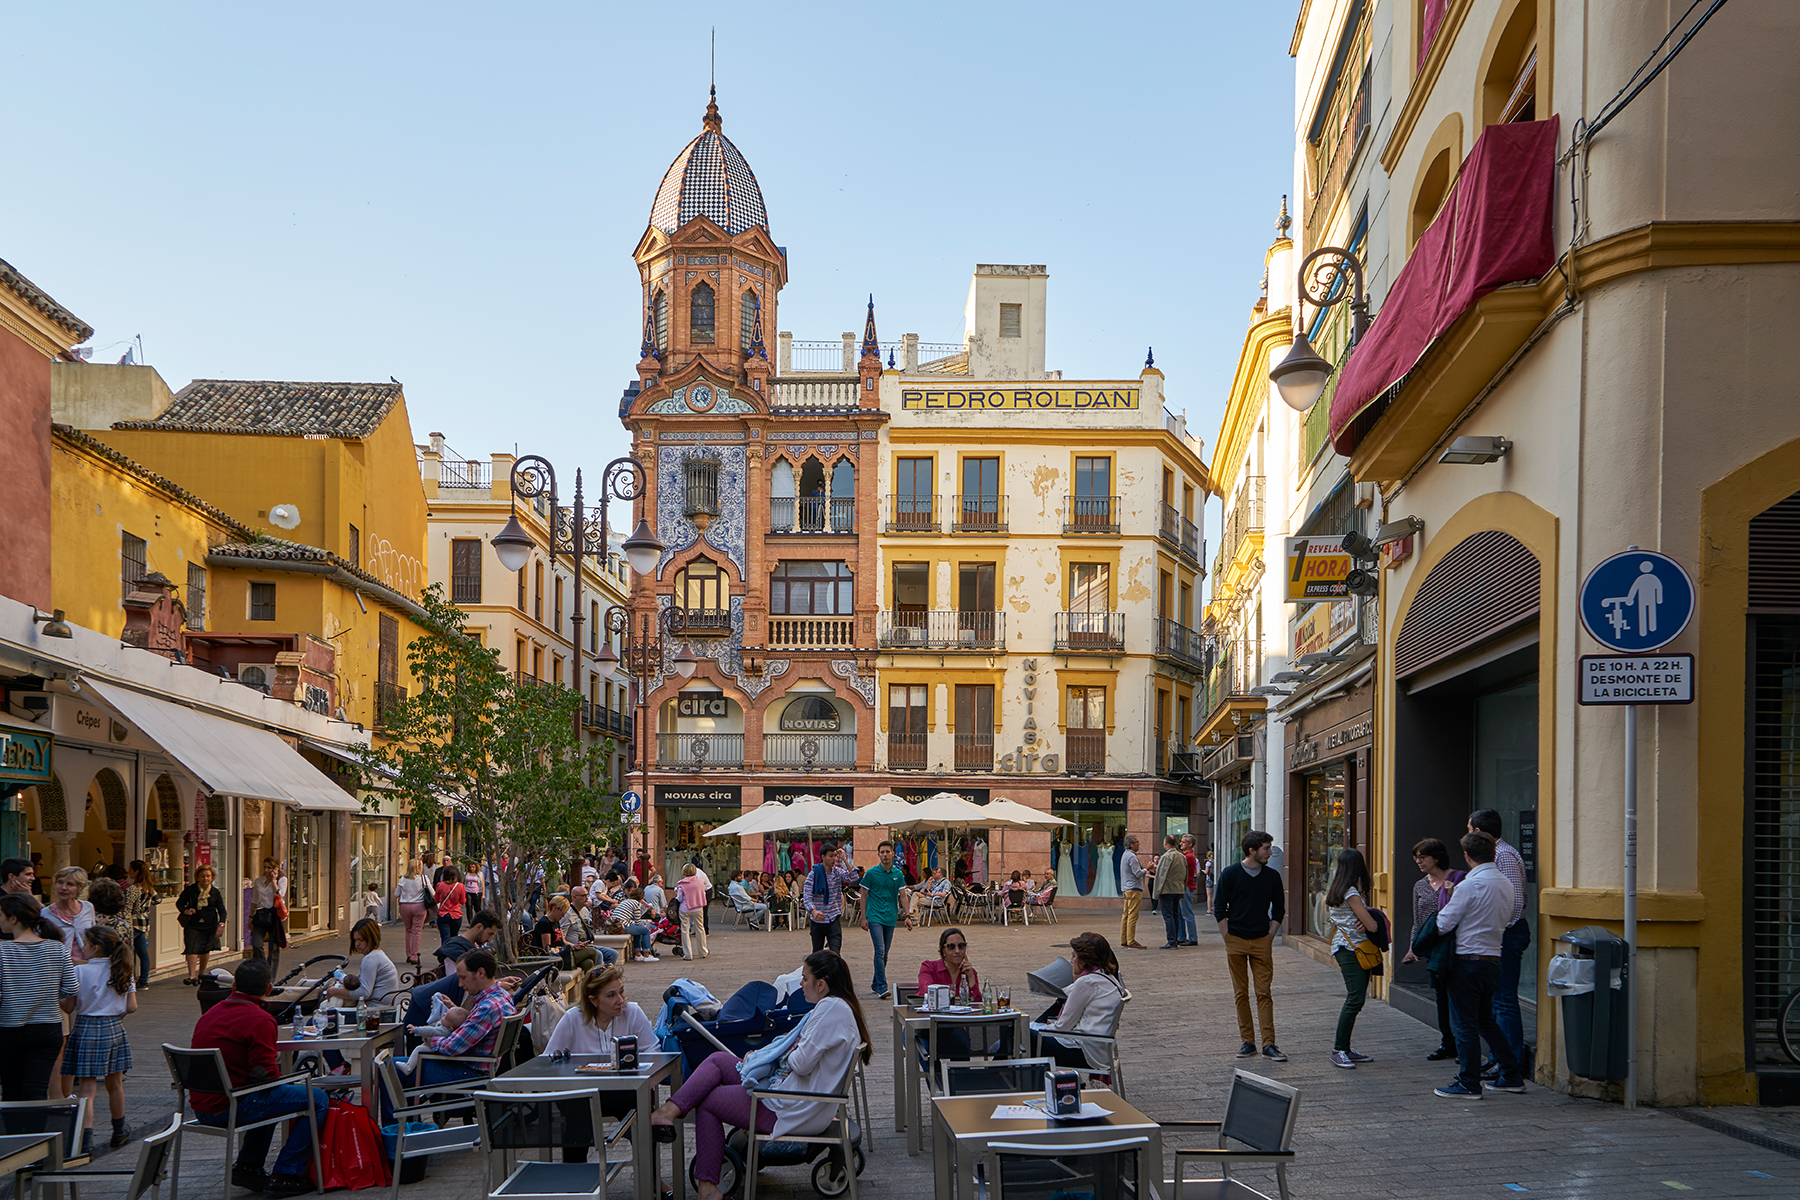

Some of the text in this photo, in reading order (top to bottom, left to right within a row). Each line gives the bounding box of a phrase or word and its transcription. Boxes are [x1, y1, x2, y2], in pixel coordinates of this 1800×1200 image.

[903, 391, 1132, 408] PEDRO ROLDAN
[1291, 539, 1309, 582] 1
[1304, 559, 1348, 577] HORA
[1307, 584, 1329, 593] EXPRESS
[1590, 660, 1683, 672] DE 10 H. A 22 H.
[1591, 674, 1681, 685] DESMONTE DE
[1594, 687, 1677, 697] LA BICICLETA
[679, 694, 726, 715] cira
[1023, 658, 1038, 745] NOVIAS
[76, 709, 101, 729] Crêpes
[784, 719, 837, 730] NOVIAS
[1000, 746, 1059, 772] cira
[664, 790, 732, 800] NOVIAS cira
[1055, 795, 1124, 804] NOVIAS cira
